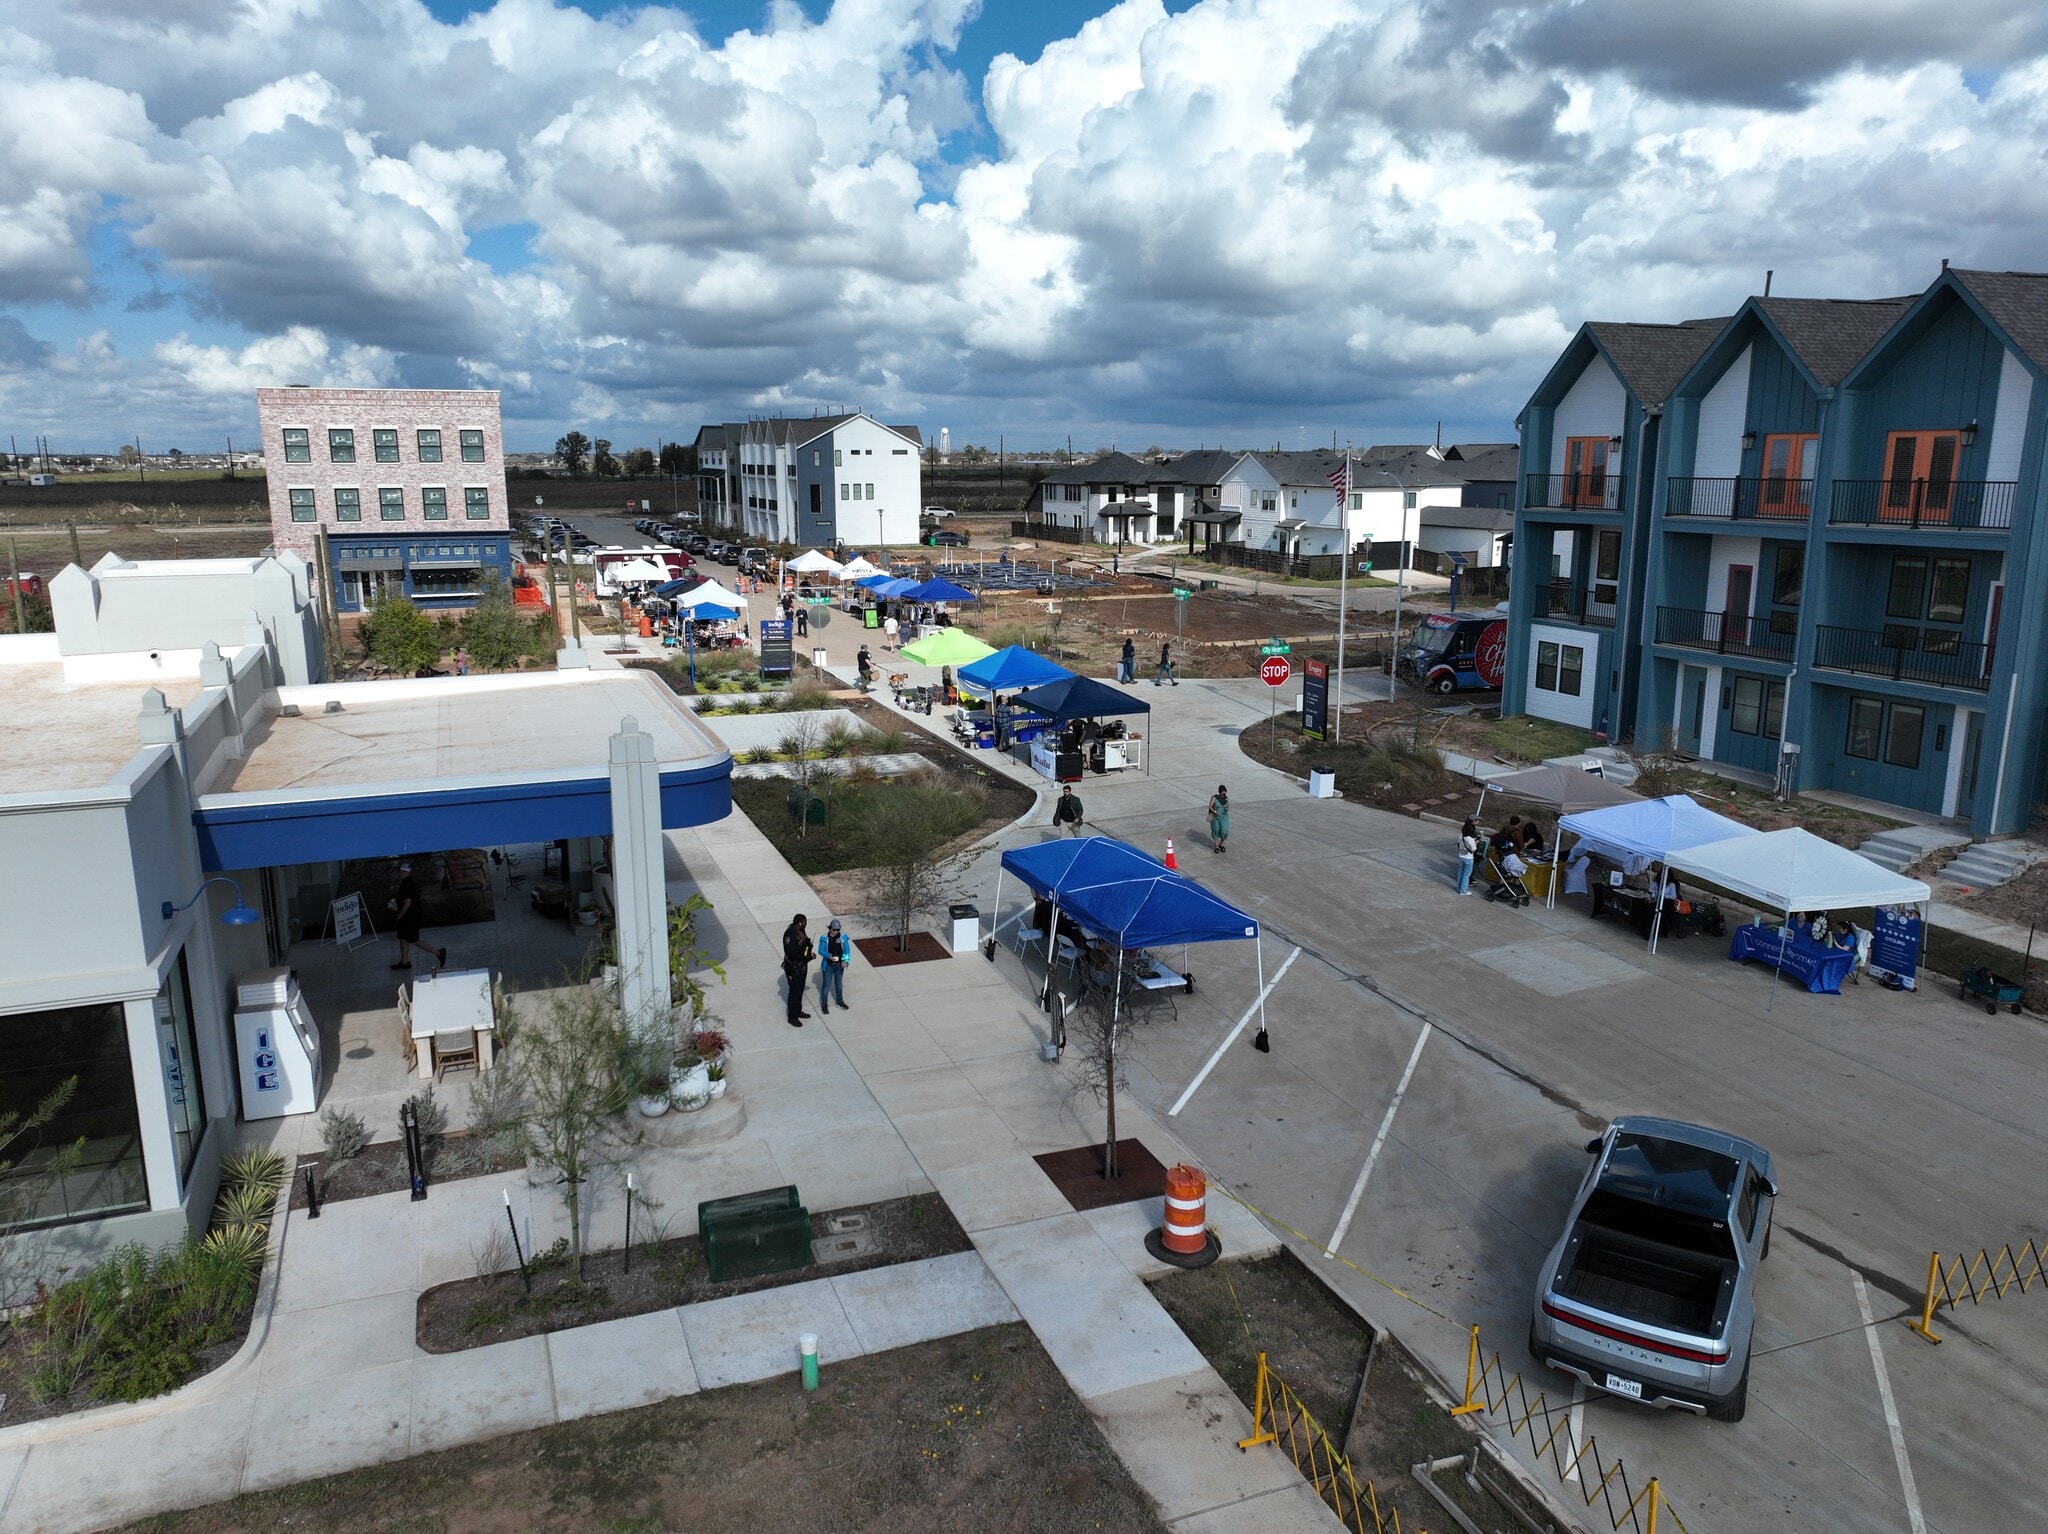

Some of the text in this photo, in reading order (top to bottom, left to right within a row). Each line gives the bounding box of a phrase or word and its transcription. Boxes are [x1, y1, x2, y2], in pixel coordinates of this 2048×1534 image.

[1263, 665, 1288, 678] STOP
[335, 901, 358, 914] indigo
[1884, 936, 1906, 947] CYCLING
[254, 1028, 279, 1091] ICE
[1593, 1336, 1663, 1363] RIVIAN
